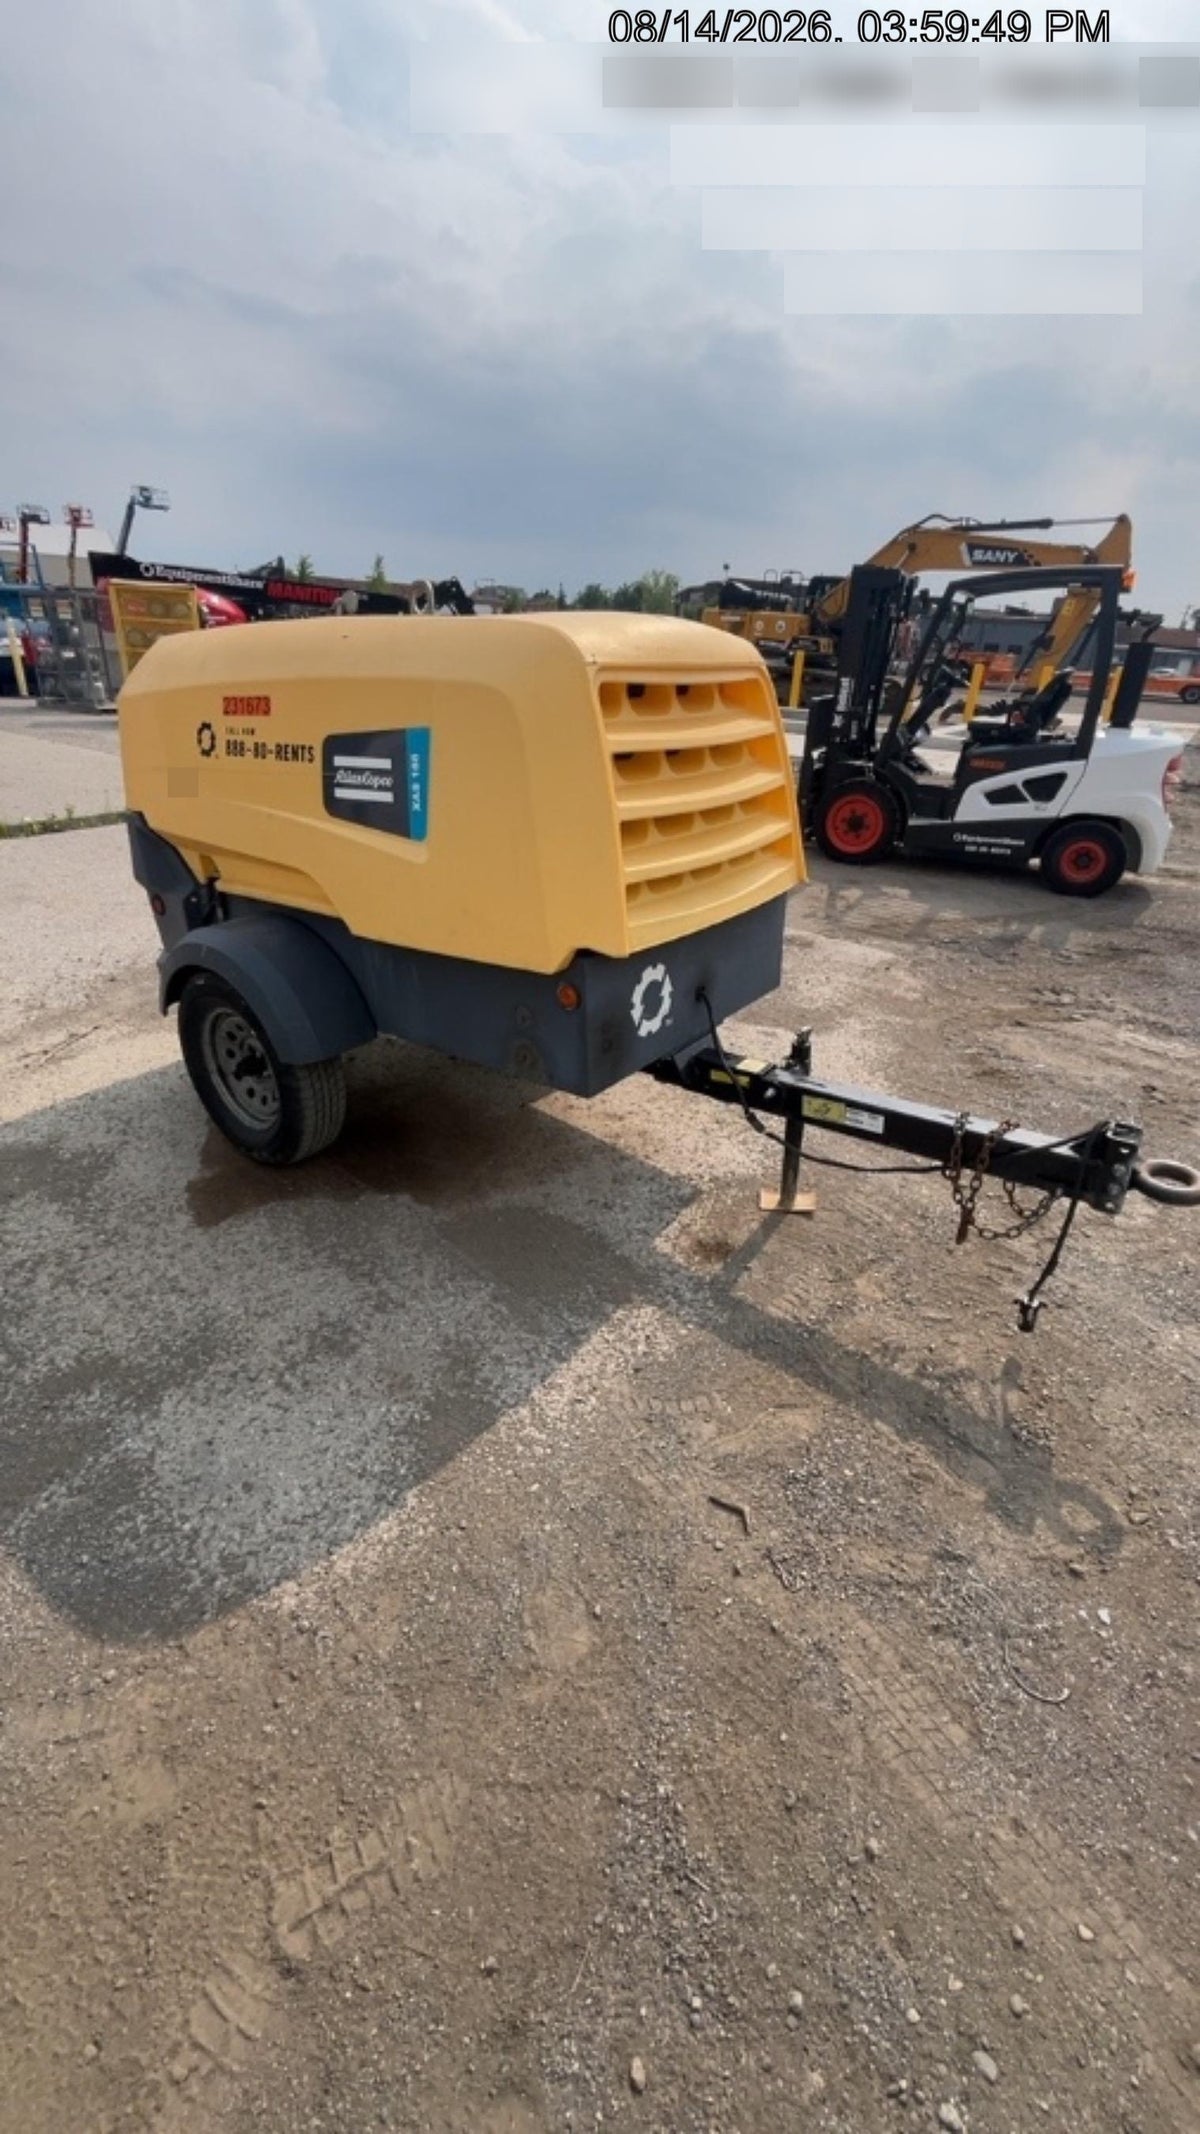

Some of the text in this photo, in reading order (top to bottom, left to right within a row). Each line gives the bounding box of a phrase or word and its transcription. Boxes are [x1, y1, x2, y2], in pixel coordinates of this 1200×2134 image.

[972, 549, 1018, 562] SANY
[223, 696, 270, 716] 231673
[226, 740, 315, 763] 888-80-RENTS
